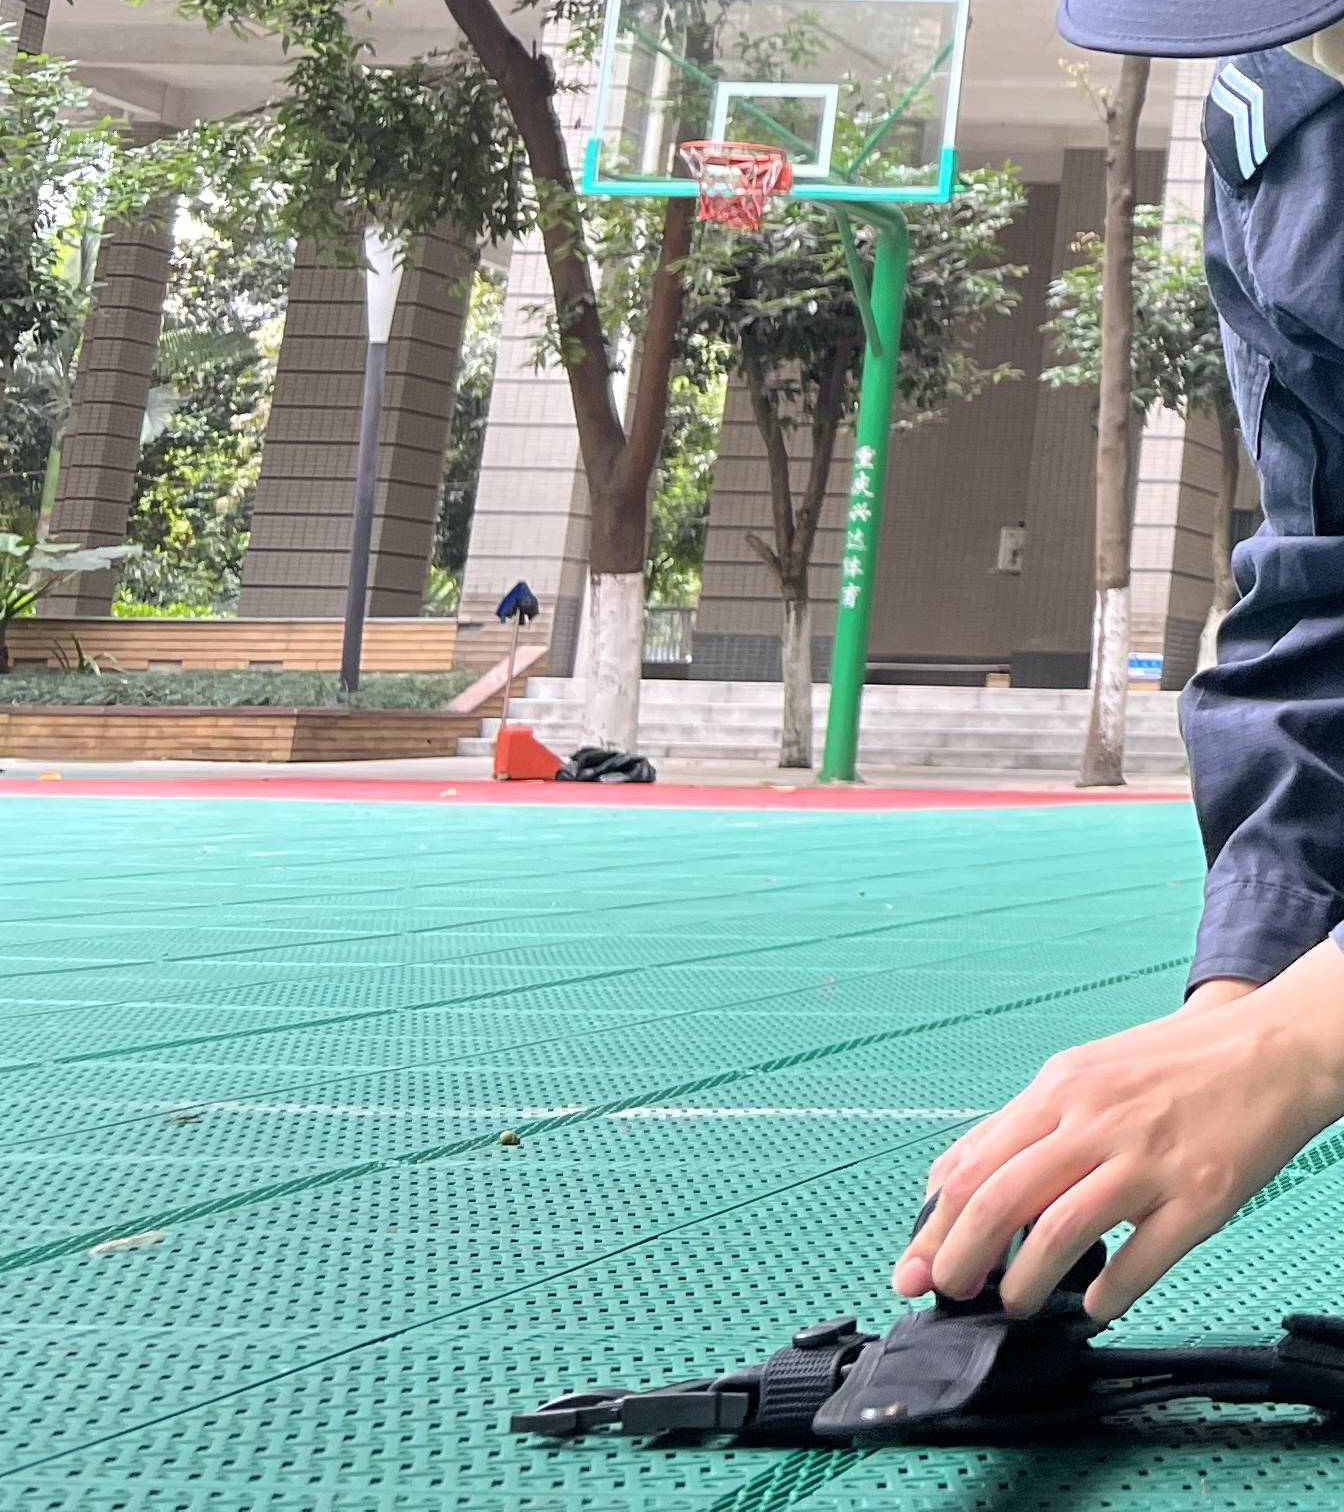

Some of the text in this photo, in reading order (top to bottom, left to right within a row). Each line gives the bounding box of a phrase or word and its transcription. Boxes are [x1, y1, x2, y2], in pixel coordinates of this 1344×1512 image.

[841, 445, 876, 608] 重庆兴达体育
